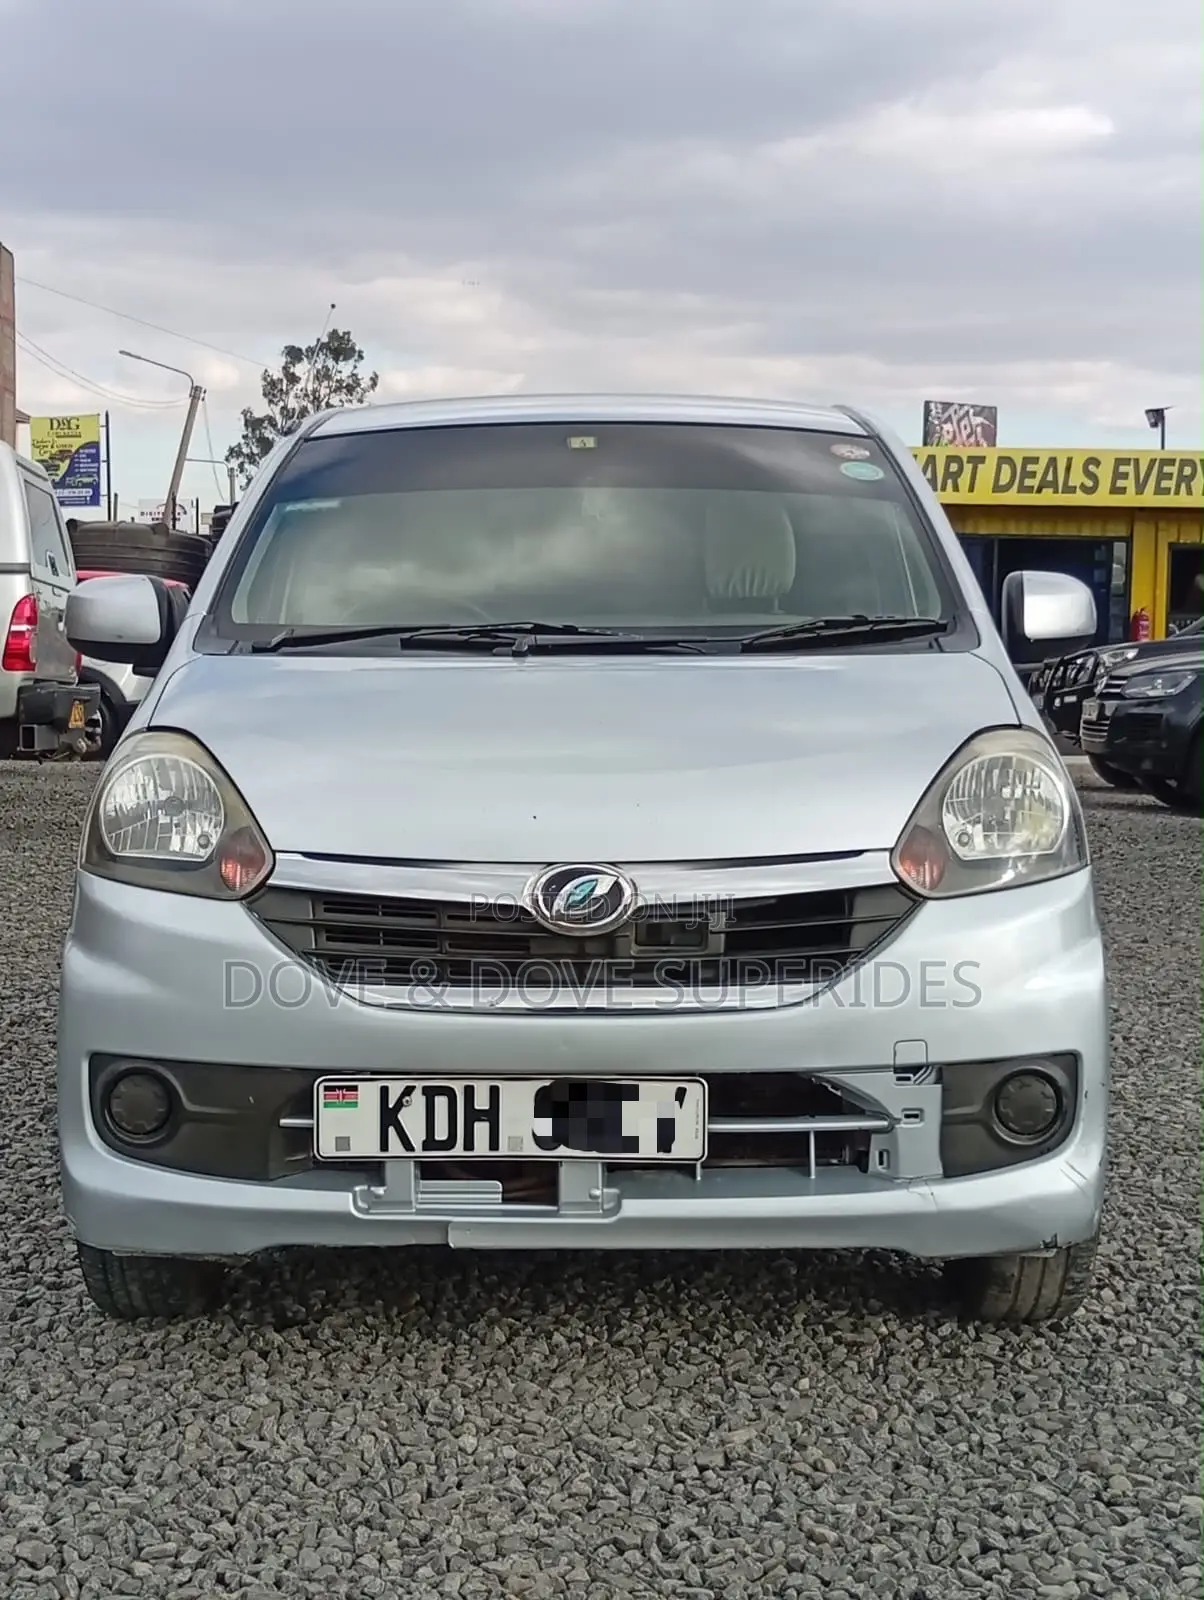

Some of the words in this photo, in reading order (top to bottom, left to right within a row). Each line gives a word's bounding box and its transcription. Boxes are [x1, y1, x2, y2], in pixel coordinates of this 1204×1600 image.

[912, 454, 986, 493] ART
[992, 456, 1102, 496] DEALS
[1109, 457, 1204, 496] EVER
[379, 1084, 500, 1152] KDH
